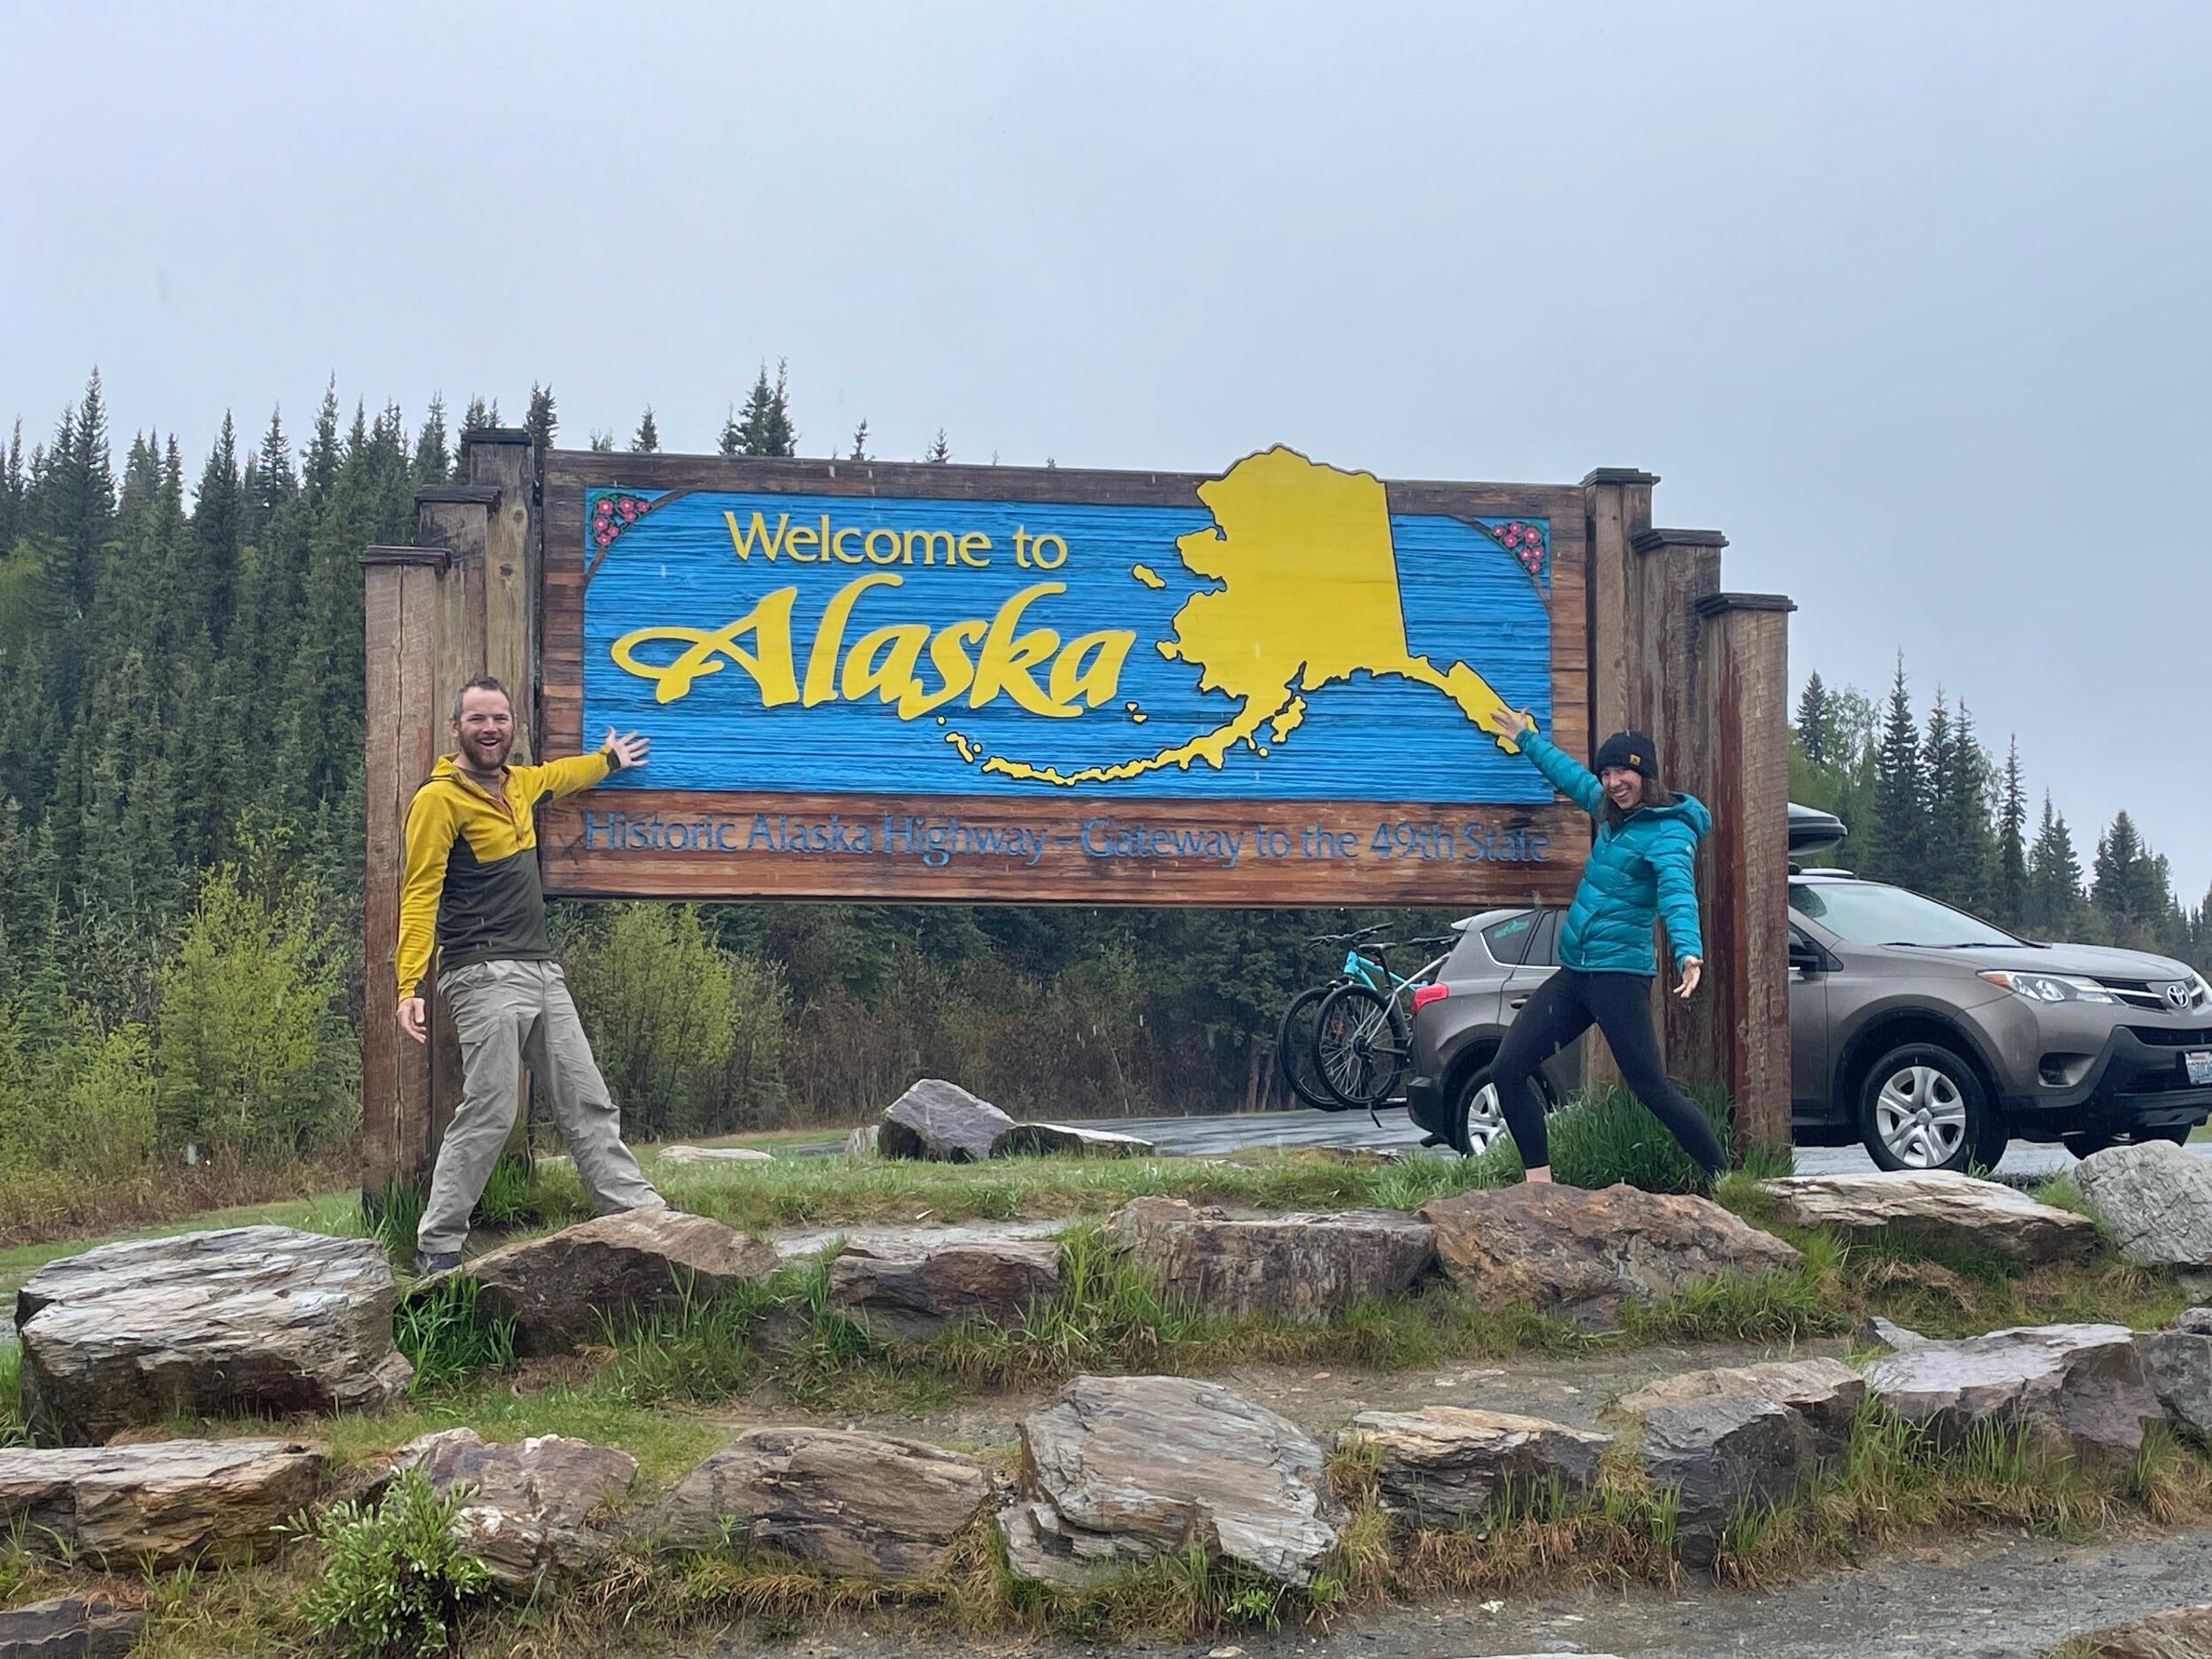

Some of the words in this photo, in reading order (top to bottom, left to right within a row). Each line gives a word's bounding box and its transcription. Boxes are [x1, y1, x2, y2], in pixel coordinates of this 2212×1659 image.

[724, 511, 992, 567] Welcome
[1012, 524, 1069, 570] to
[611, 572, 1137, 720] Alaska
[585, 811, 737, 852] Historic
[746, 812, 874, 855] Alaska
[884, 814, 1048, 867] Highway
[1080, 817, 1245, 869] Gateway
[1254, 824, 1291, 859] to
[1301, 821, 1359, 861] the
[1369, 821, 1455, 862] 49th
[1462, 821, 1552, 864] State
